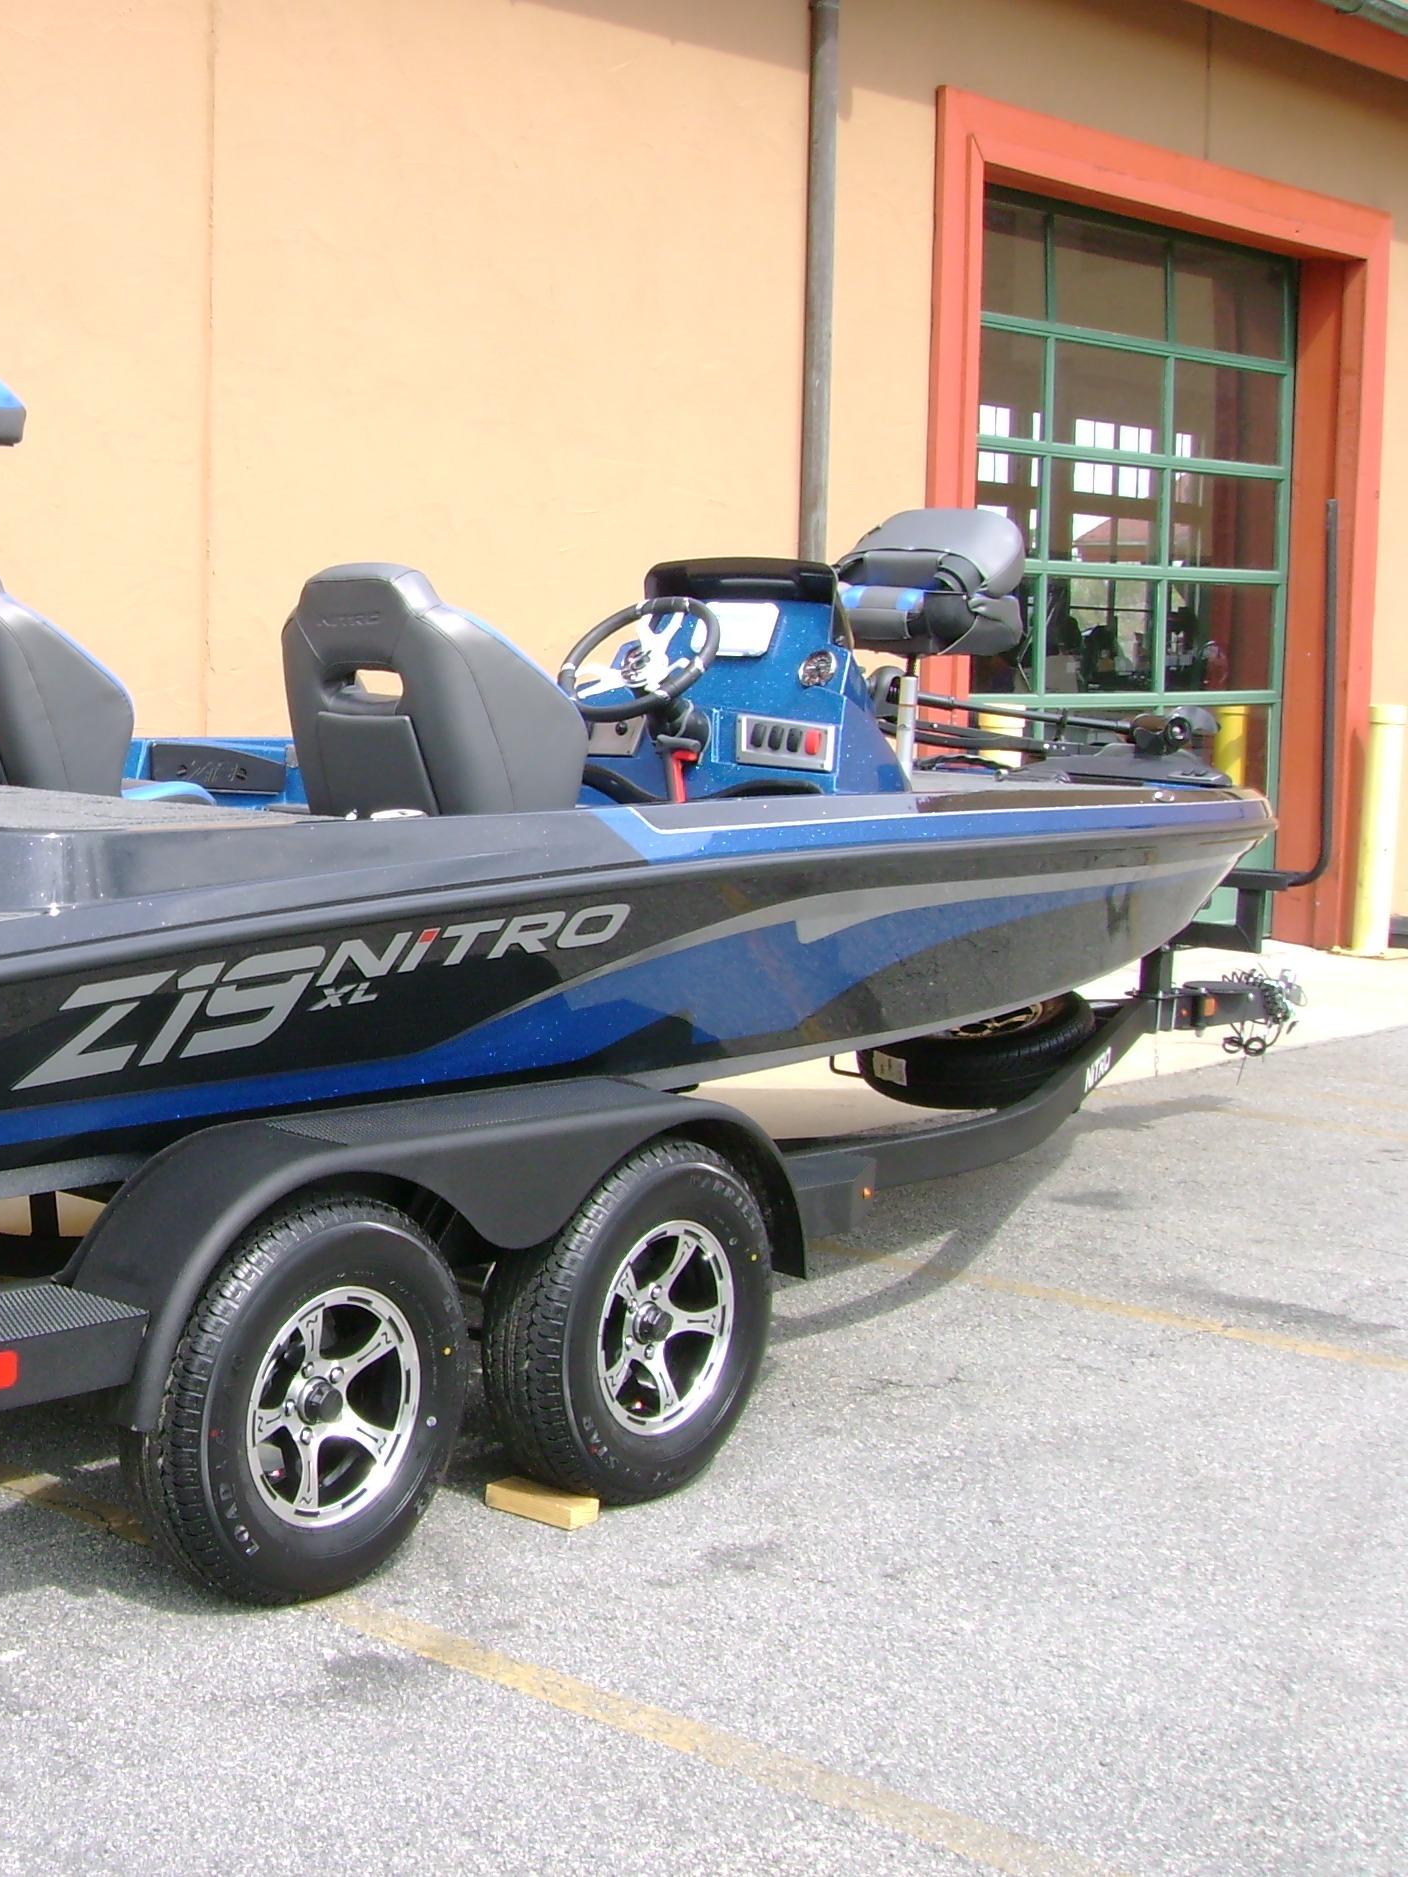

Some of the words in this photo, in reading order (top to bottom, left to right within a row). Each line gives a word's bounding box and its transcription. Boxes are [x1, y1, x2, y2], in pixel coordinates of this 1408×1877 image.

[318, 903, 631, 985] NITRO
[10, 945, 327, 1091] Z19
[306, 982, 378, 1012] XL
[1083, 1045, 1112, 1094] NITRO
